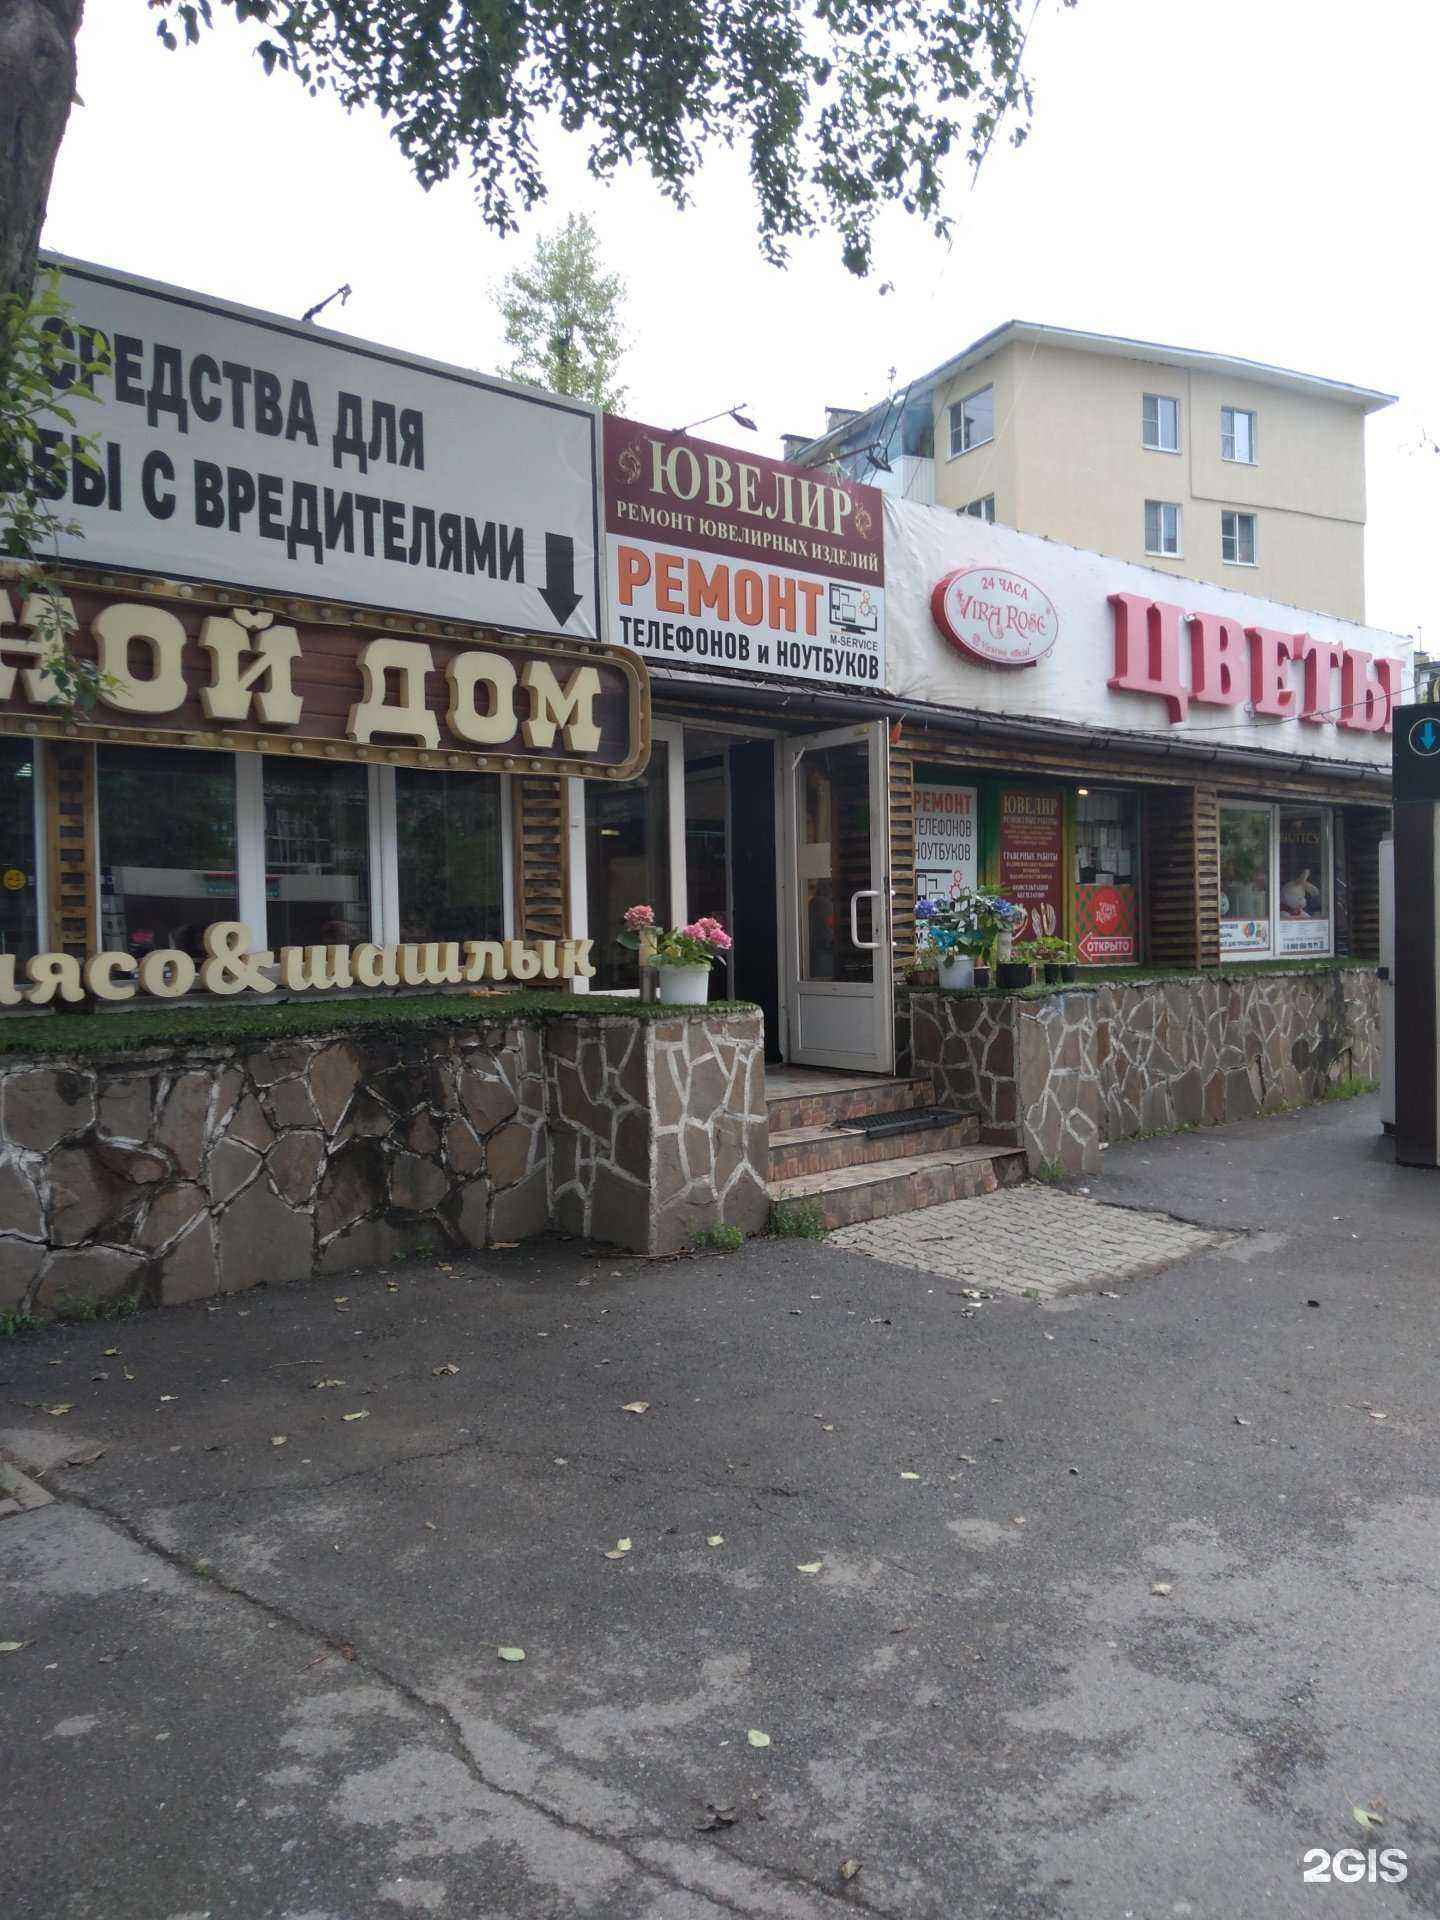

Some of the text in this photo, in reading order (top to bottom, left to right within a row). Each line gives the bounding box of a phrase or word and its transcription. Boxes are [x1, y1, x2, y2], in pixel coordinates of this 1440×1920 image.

[40, 317, 425, 475] СРЕДСТВА ДЛЯ
[0, 426, 526, 585] БЫ С ВРЕДИТЕЛЯМИ
[646, 438, 853, 536] ЮВЕЛИР
[616, 499, 879, 573] РЕМОНТ ЮВЕЛИРНЫХ ИЗДЕЛИЙ
[616, 544, 824, 637] РЕМОНТ
[981, 577, 1028, 600] 24 ЧАСА
[618, 614, 750, 662] ТЕЛЕФОНОВ
[776, 639, 879, 681] НОУТБУКОВ
[829, 634, 879, 652] M-SERVICE
[1107, 591, 1406, 734] ЦВЕТЫ
[345, 638, 603, 753] ДОМ
[914, 789, 972, 816] РЕМОНТ
[1086, 941, 1129, 953] ОТКРЫТО
